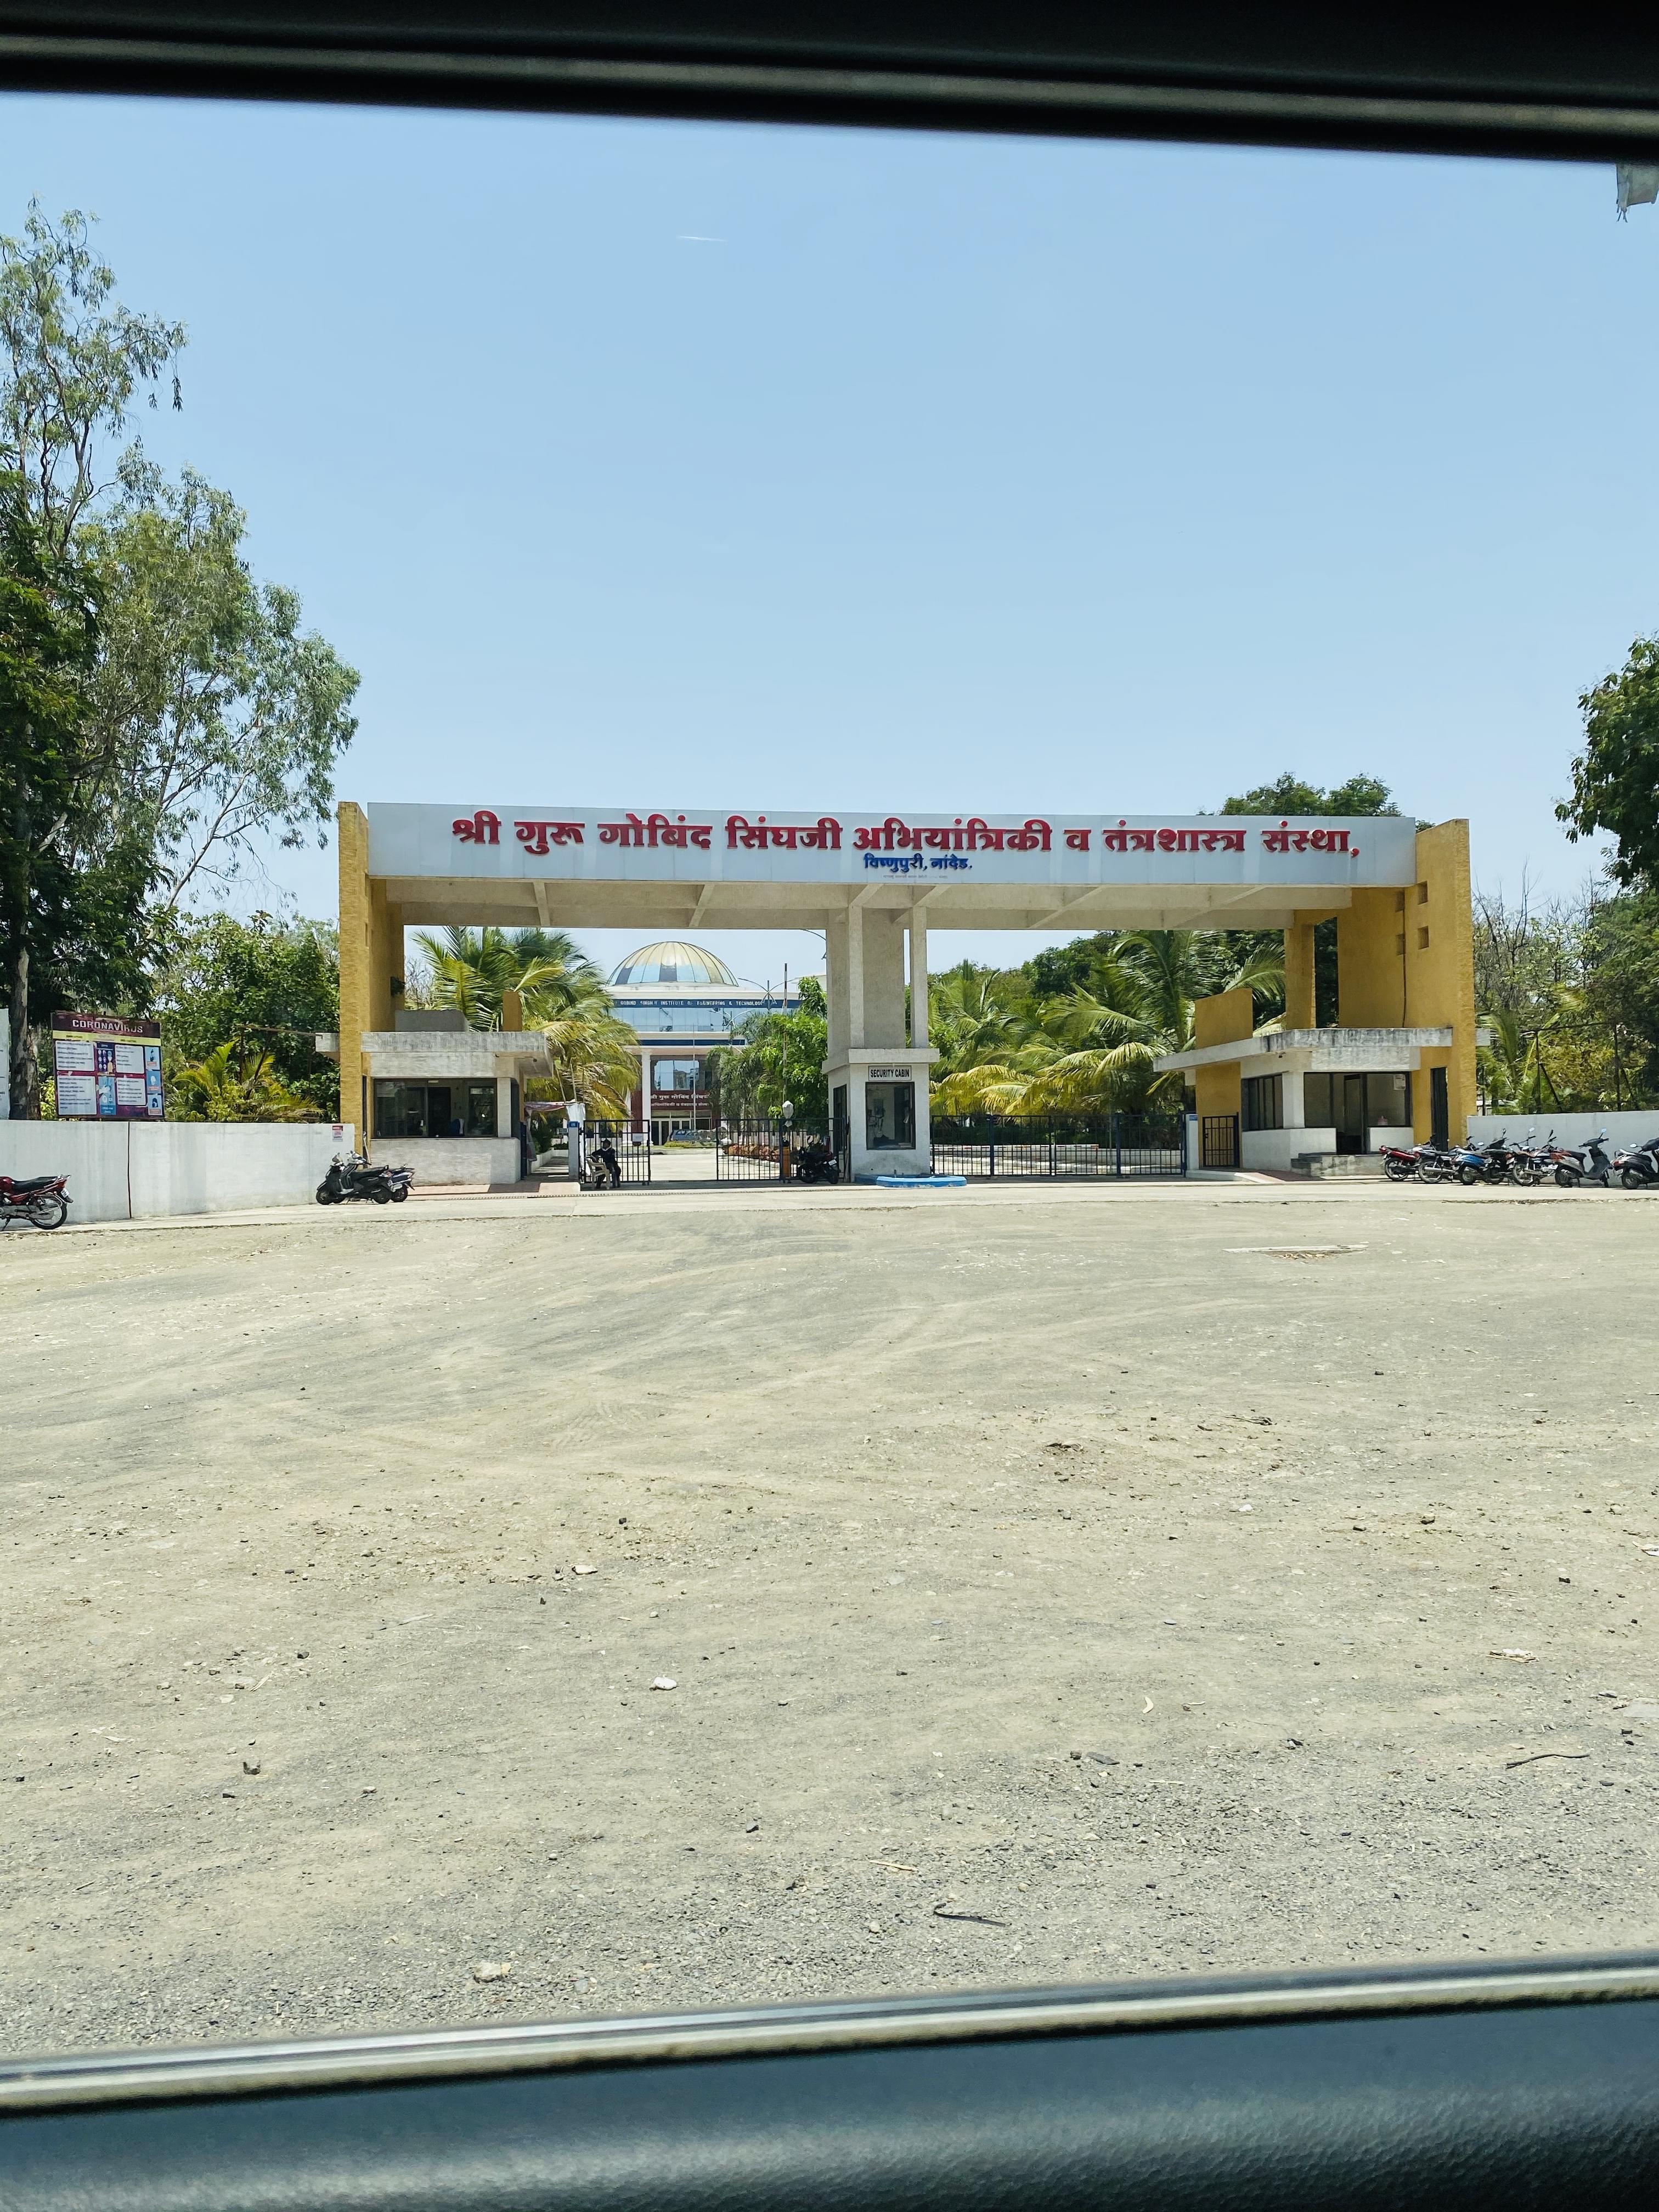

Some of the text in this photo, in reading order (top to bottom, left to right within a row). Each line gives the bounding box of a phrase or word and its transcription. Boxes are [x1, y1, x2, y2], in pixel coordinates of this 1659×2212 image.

[453, 810, 1360, 857] श्री गुरू गोबिंद सिंघजी अभियांत्रिकी व तंत्रशास्त्र संस्था,
[864, 853, 928, 873] विष्णुपुरी,
[870, 1069, 910, 1077] SECURITY CABIN
